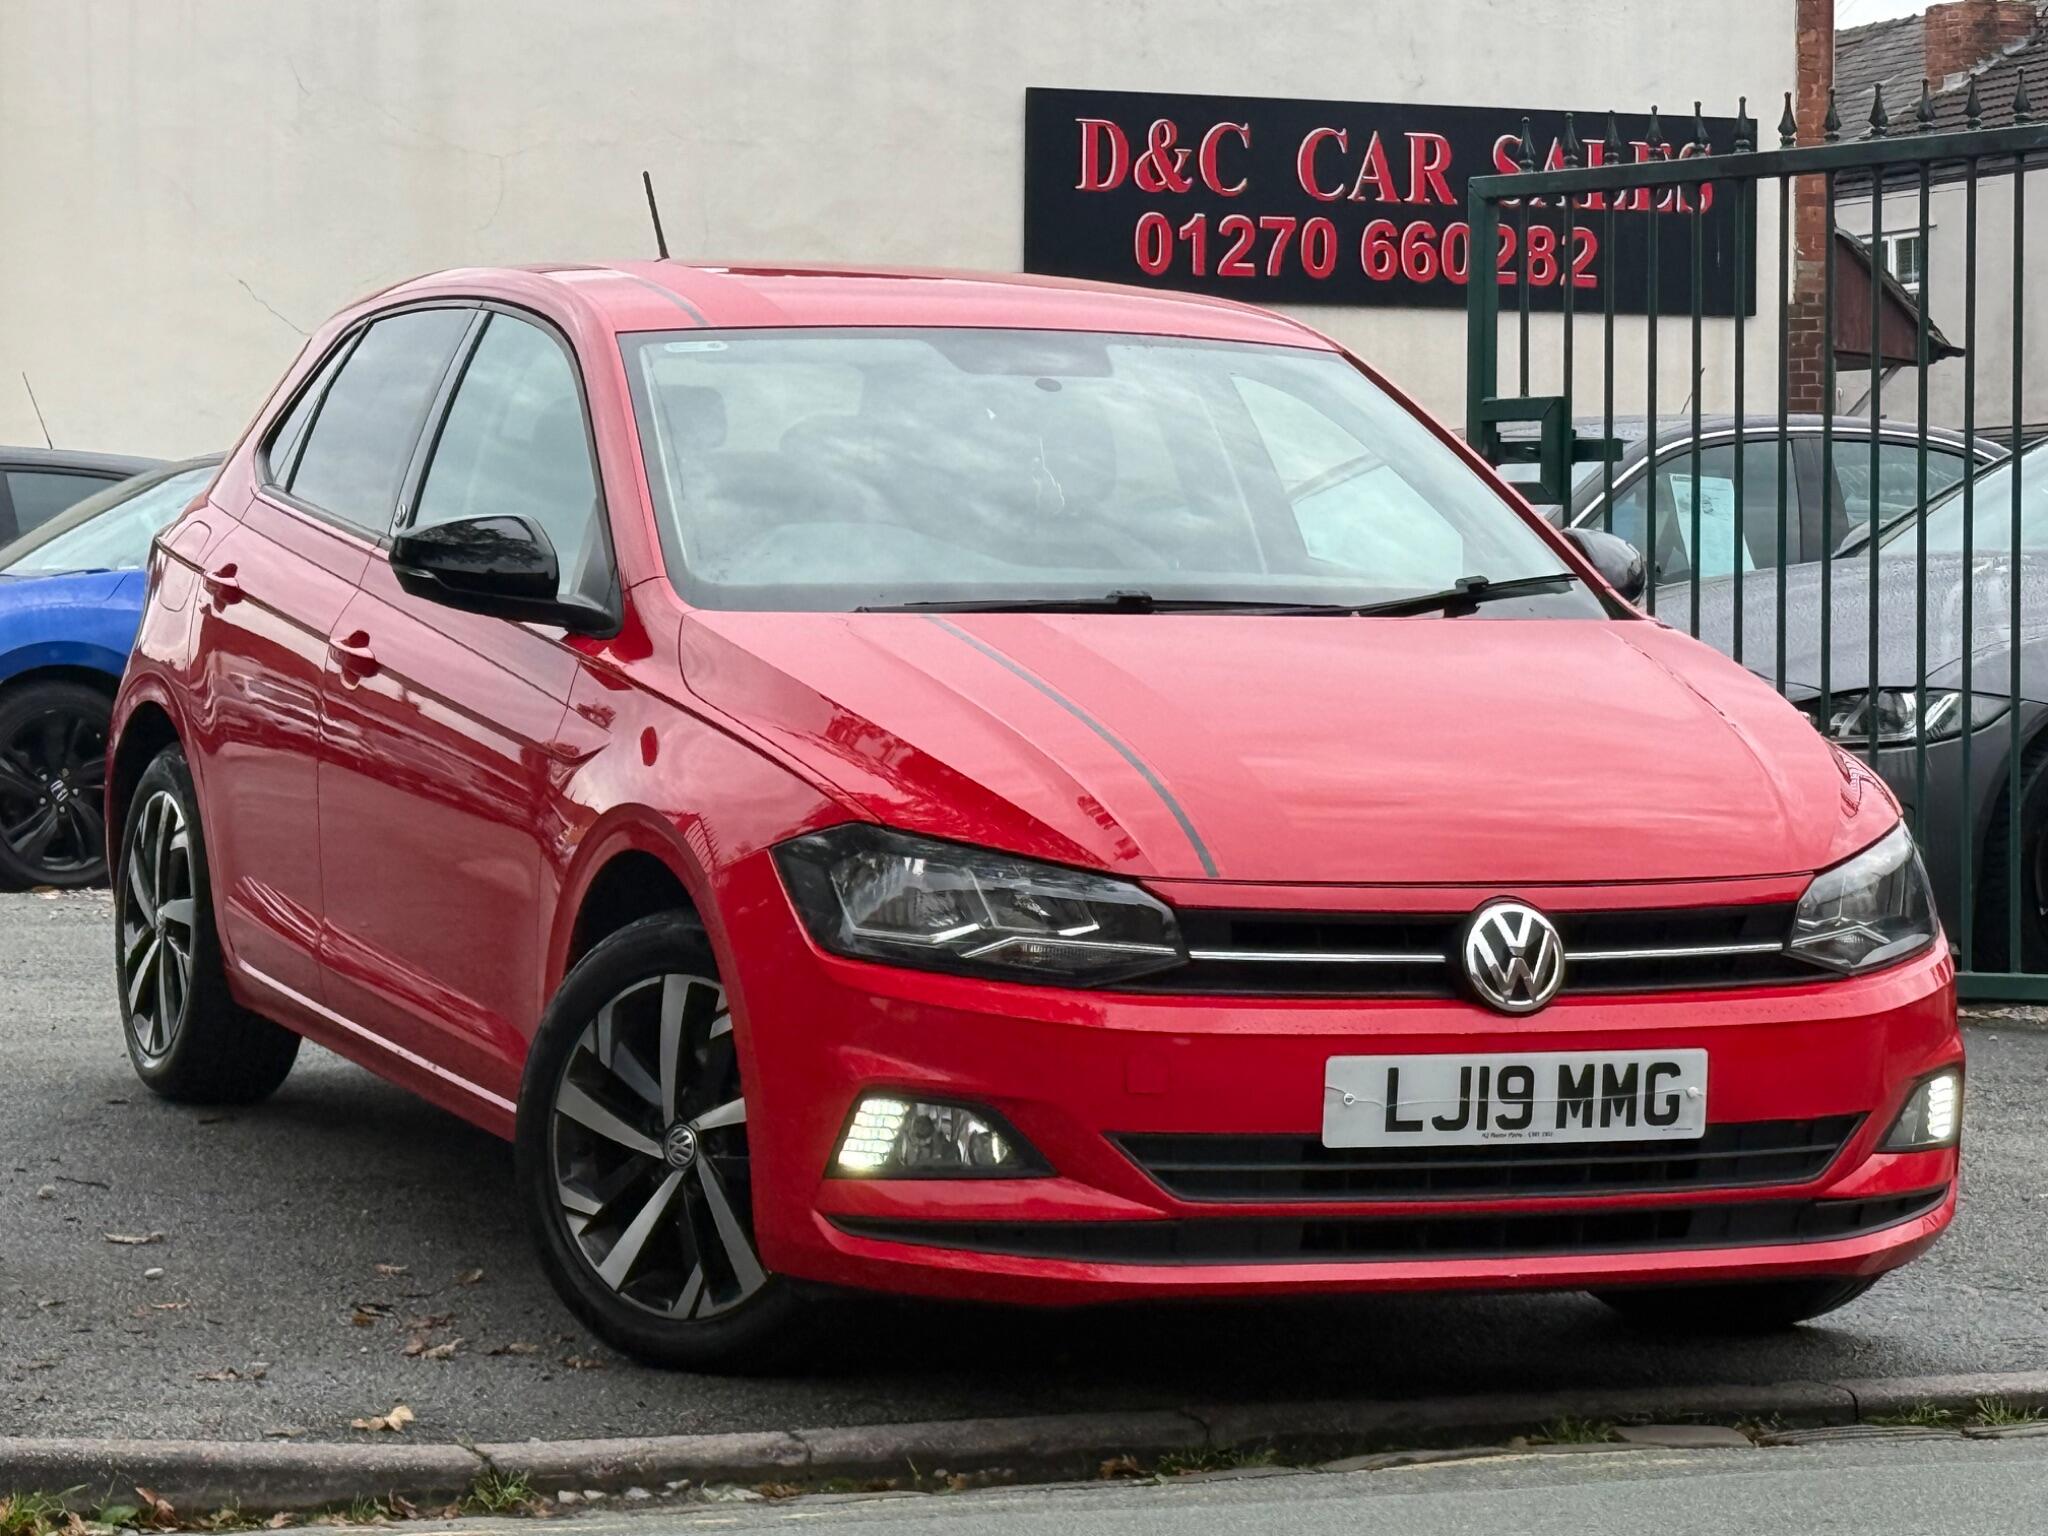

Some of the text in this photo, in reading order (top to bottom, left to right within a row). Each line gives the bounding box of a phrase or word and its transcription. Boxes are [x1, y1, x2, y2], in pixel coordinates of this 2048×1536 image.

[1074, 118, 1250, 198] D&C
[1297, 126, 1458, 207] CAR
[1134, 211, 1598, 289] 01270 660282
[1384, 1062, 1682, 1133] LJ19 MMG
